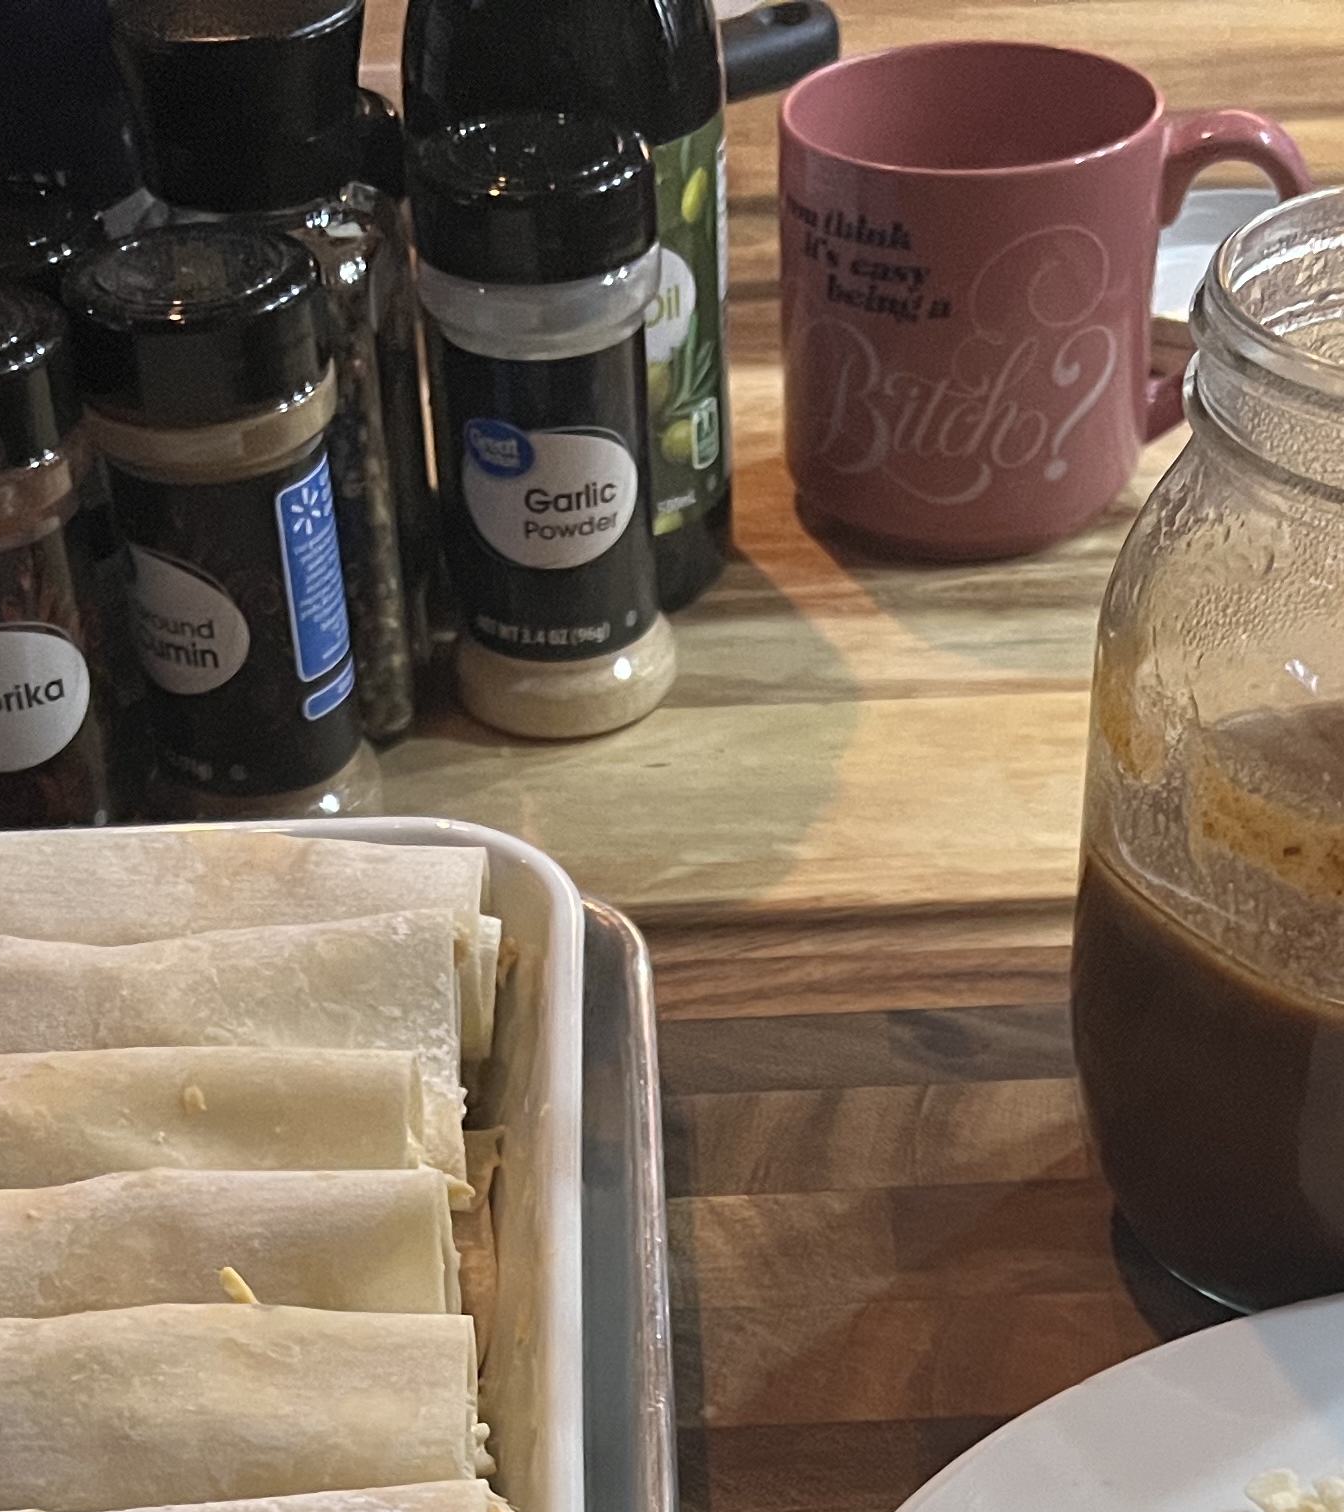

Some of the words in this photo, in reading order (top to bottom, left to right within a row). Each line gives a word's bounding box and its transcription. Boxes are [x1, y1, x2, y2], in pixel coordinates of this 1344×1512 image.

[824, 209, 912, 251] think
[850, 258, 931, 295] easy
[827, 273, 925, 325] being
[523, 481, 617, 515] Garlic
[524, 512, 618, 541] Powder
